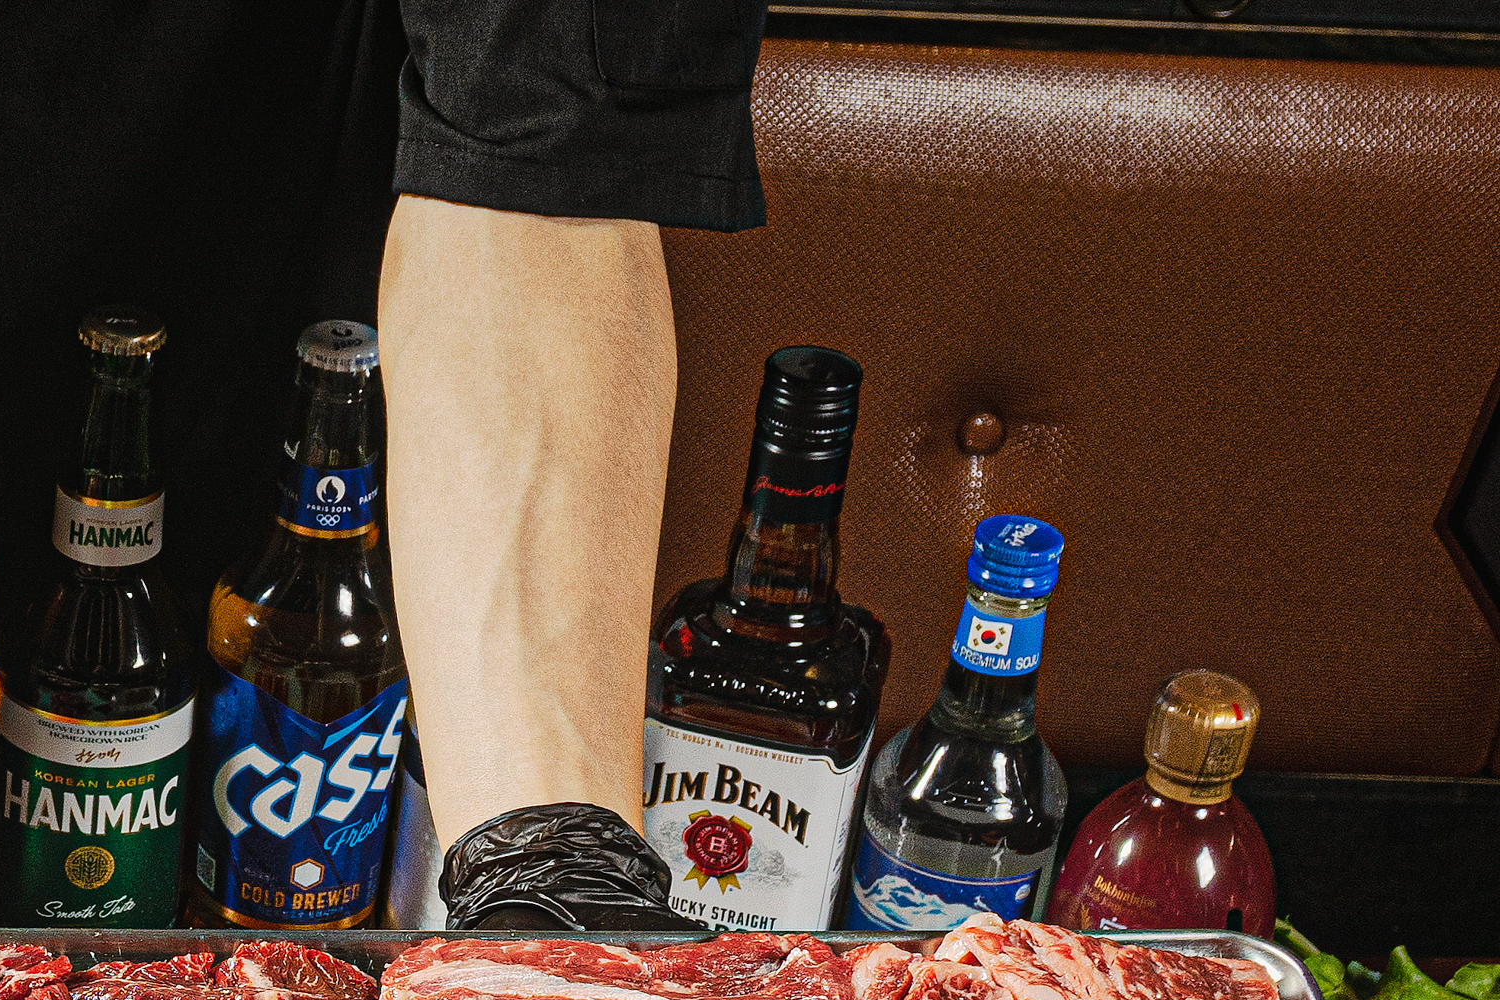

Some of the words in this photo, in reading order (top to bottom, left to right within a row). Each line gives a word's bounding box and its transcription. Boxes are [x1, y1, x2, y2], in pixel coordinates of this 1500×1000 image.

[306, 503, 329, 512] PARIS
[69, 519, 155, 548] HANMAC
[959, 646, 1011, 671] PREMIUM
[38, 719, 85, 735] BREWED
[88, 729, 118, 737] WITH
[120, 724, 160, 736] KOREAN
[666, 729, 679, 739] THE
[682, 734, 711, 746] WORLD'S
[735, 745, 768, 758] BOURBON
[771, 752, 804, 765] WHISKEY
[34, 769, 98, 788] KOREAN
[106, 773, 155, 789] LAGER
[4, 770, 179, 835] HANMAC
[642, 762, 709, 809] JIM
[711, 763, 811, 846] BEAM
[323, 797, 388, 856] Fresh
[35, 900, 97, 919] Smooth
[99, 895, 136, 918] Taste
[241, 883, 285, 908] COLD
[292, 883, 360, 910] BREWED
[710, 906, 777, 931] STRAIGHT
